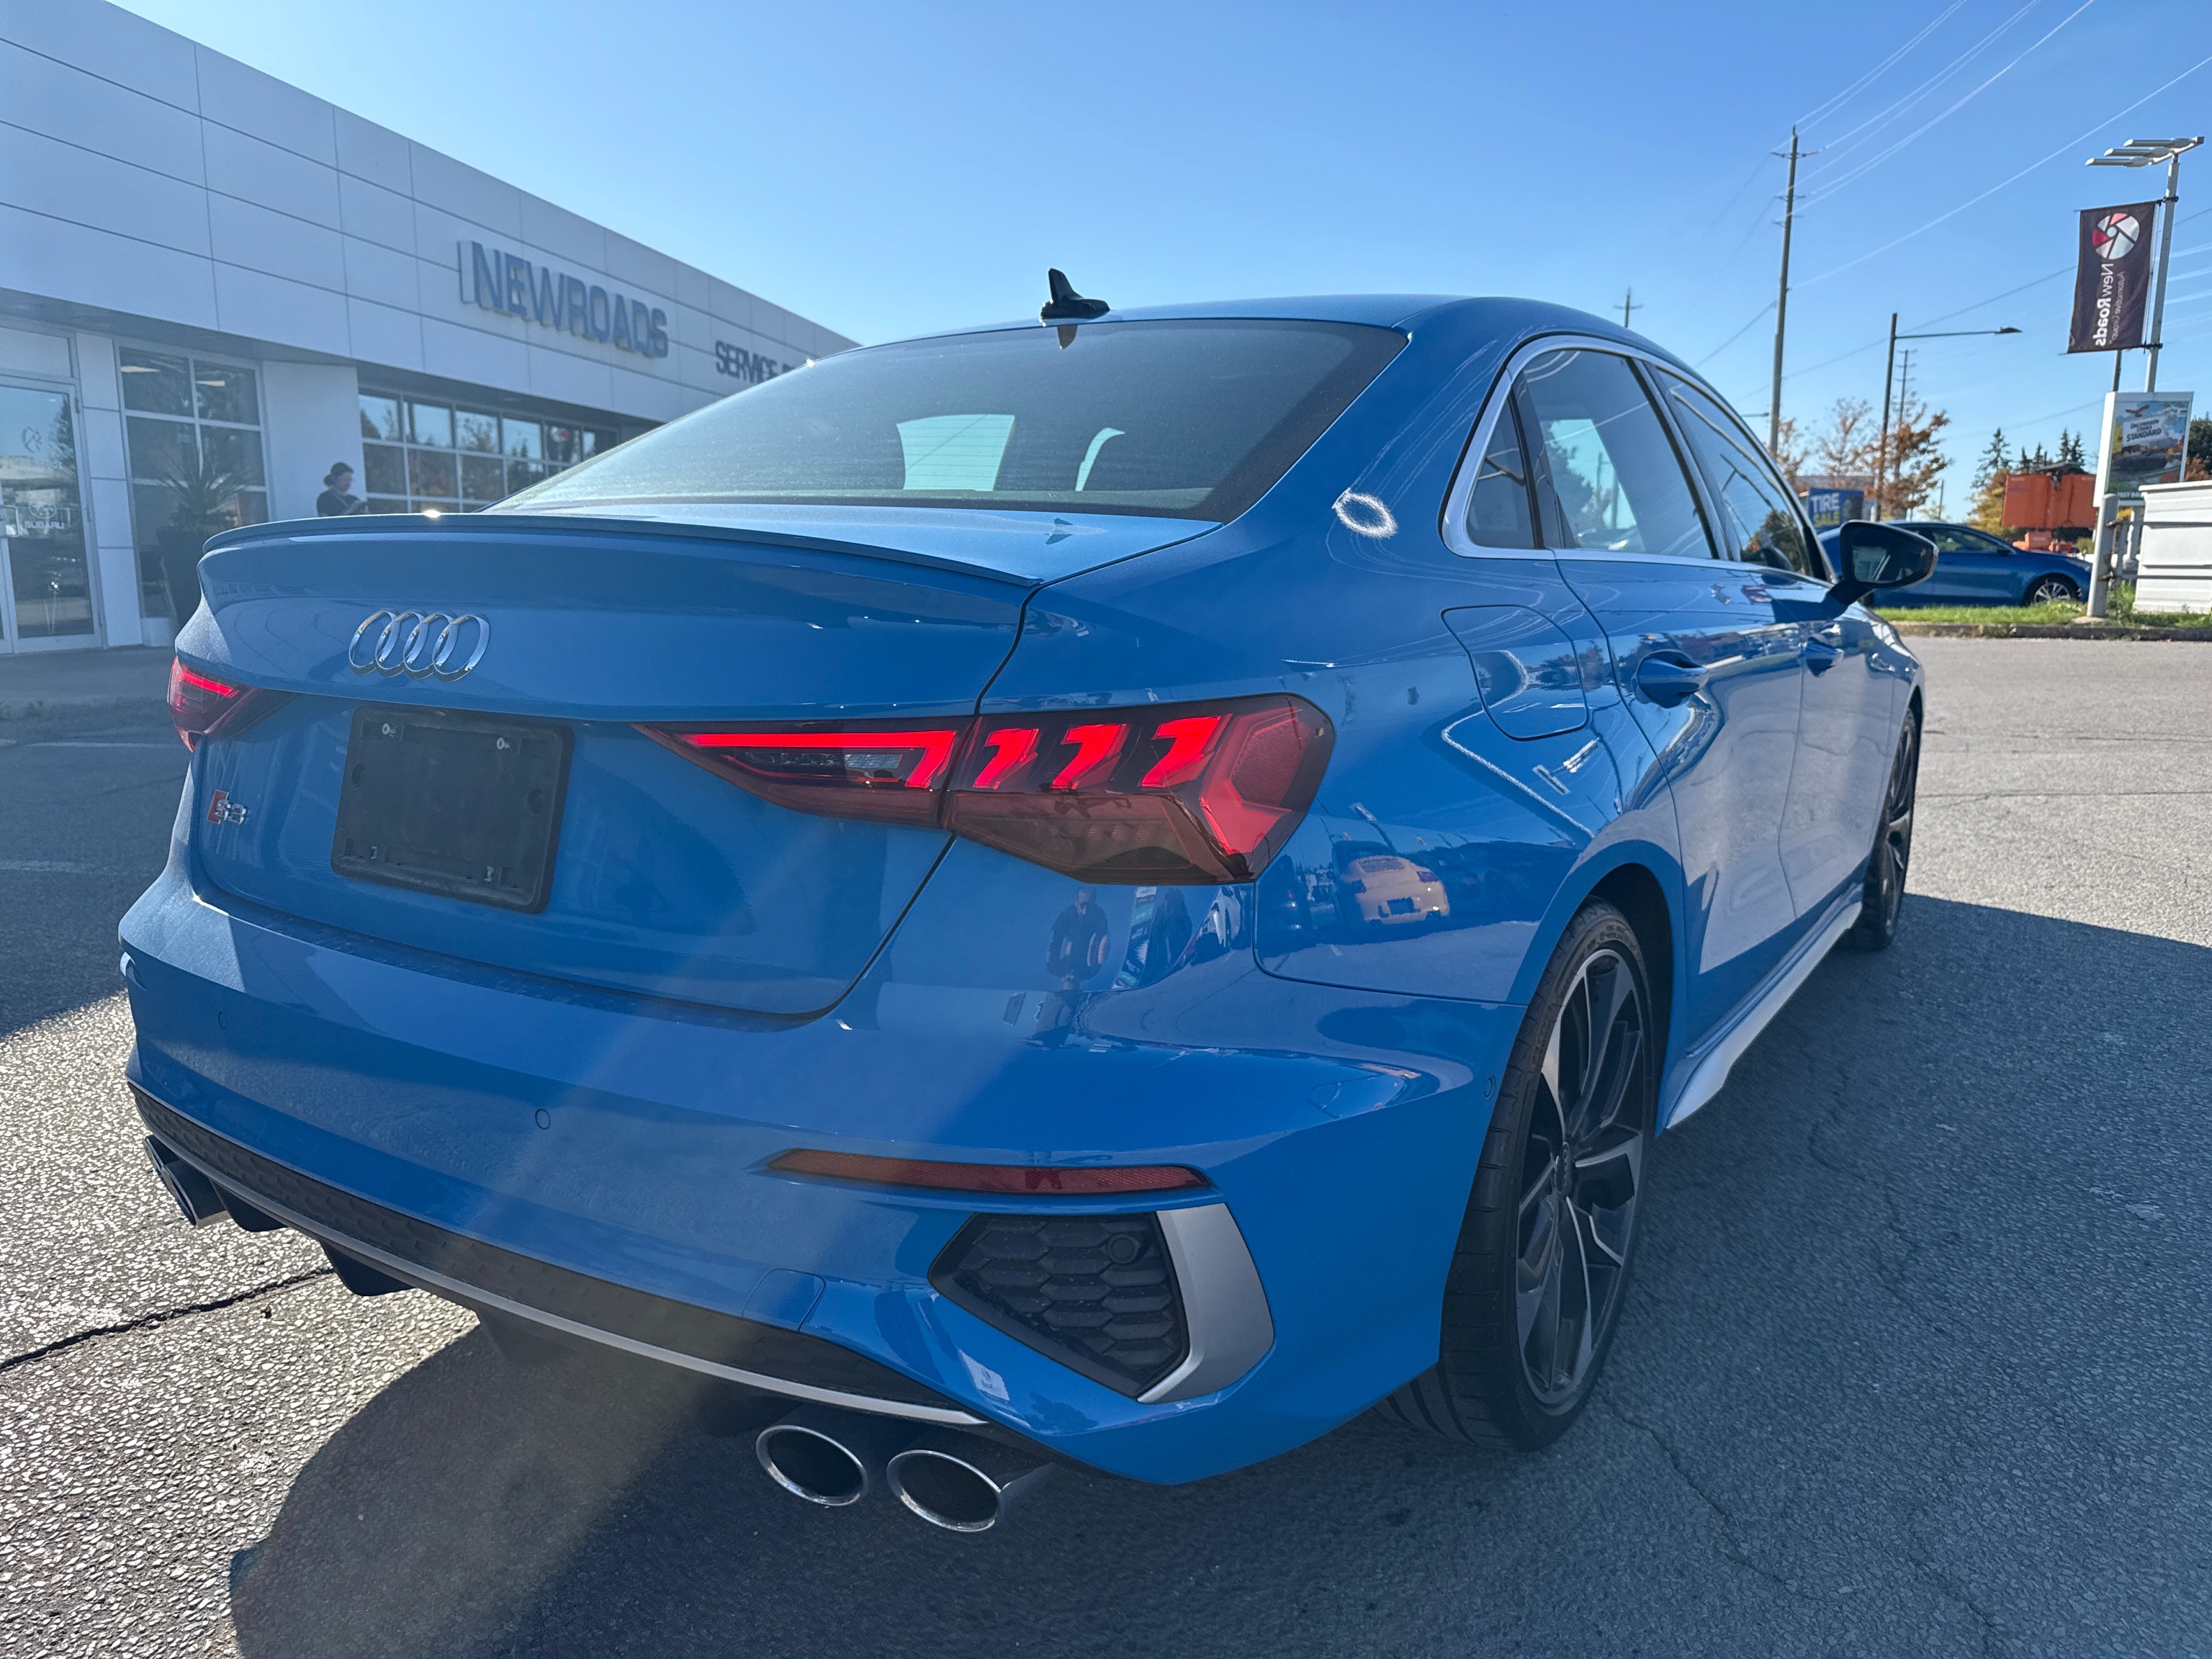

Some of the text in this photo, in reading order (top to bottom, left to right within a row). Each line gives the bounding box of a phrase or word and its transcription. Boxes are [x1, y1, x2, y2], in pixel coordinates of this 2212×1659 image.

[459, 240, 669, 359] NEWROADS
[2126, 428, 2162, 442] STANDARD
[1811, 493, 1840, 513] TIRE
[24, 520, 64, 530] SUBARU
[1814, 511, 1840, 529] SALE
[210, 795, 246, 825] S3
